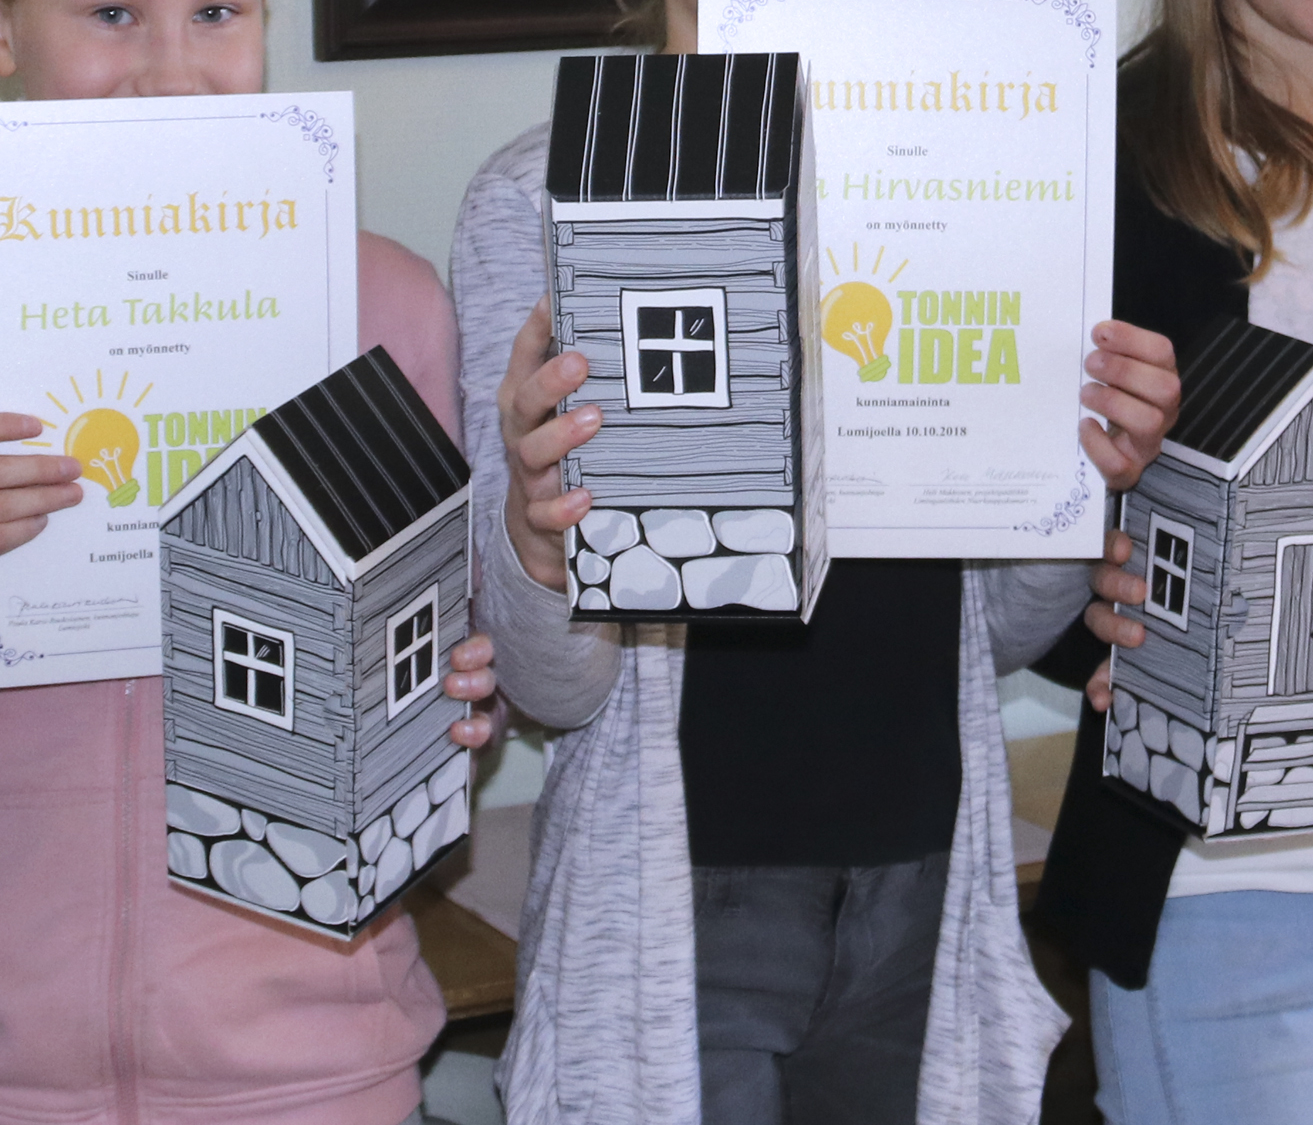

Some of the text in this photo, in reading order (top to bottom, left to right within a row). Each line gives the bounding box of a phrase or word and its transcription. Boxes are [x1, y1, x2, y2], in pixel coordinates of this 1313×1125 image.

[811, 69, 1060, 121] unniakirja
[886, 145, 930, 158] Sinulle
[841, 169, 1076, 203] Hirvasniemi
[866, 219, 949, 233] on myönnetty
[126, 269, 169, 282] Sinulle
[20, 291, 281, 331] Heta Takkula
[896, 290, 1023, 326] TONNIN
[108, 343, 191, 357] on myönnetty
[897, 328, 1022, 385] IDEA
[856, 397, 951, 408] kunniamaininta
[837, 426, 968, 439] Lumijoella 10.10.2018
[106, 520, 160, 532] kunniam
[89, 549, 154, 564] Lumijoella
